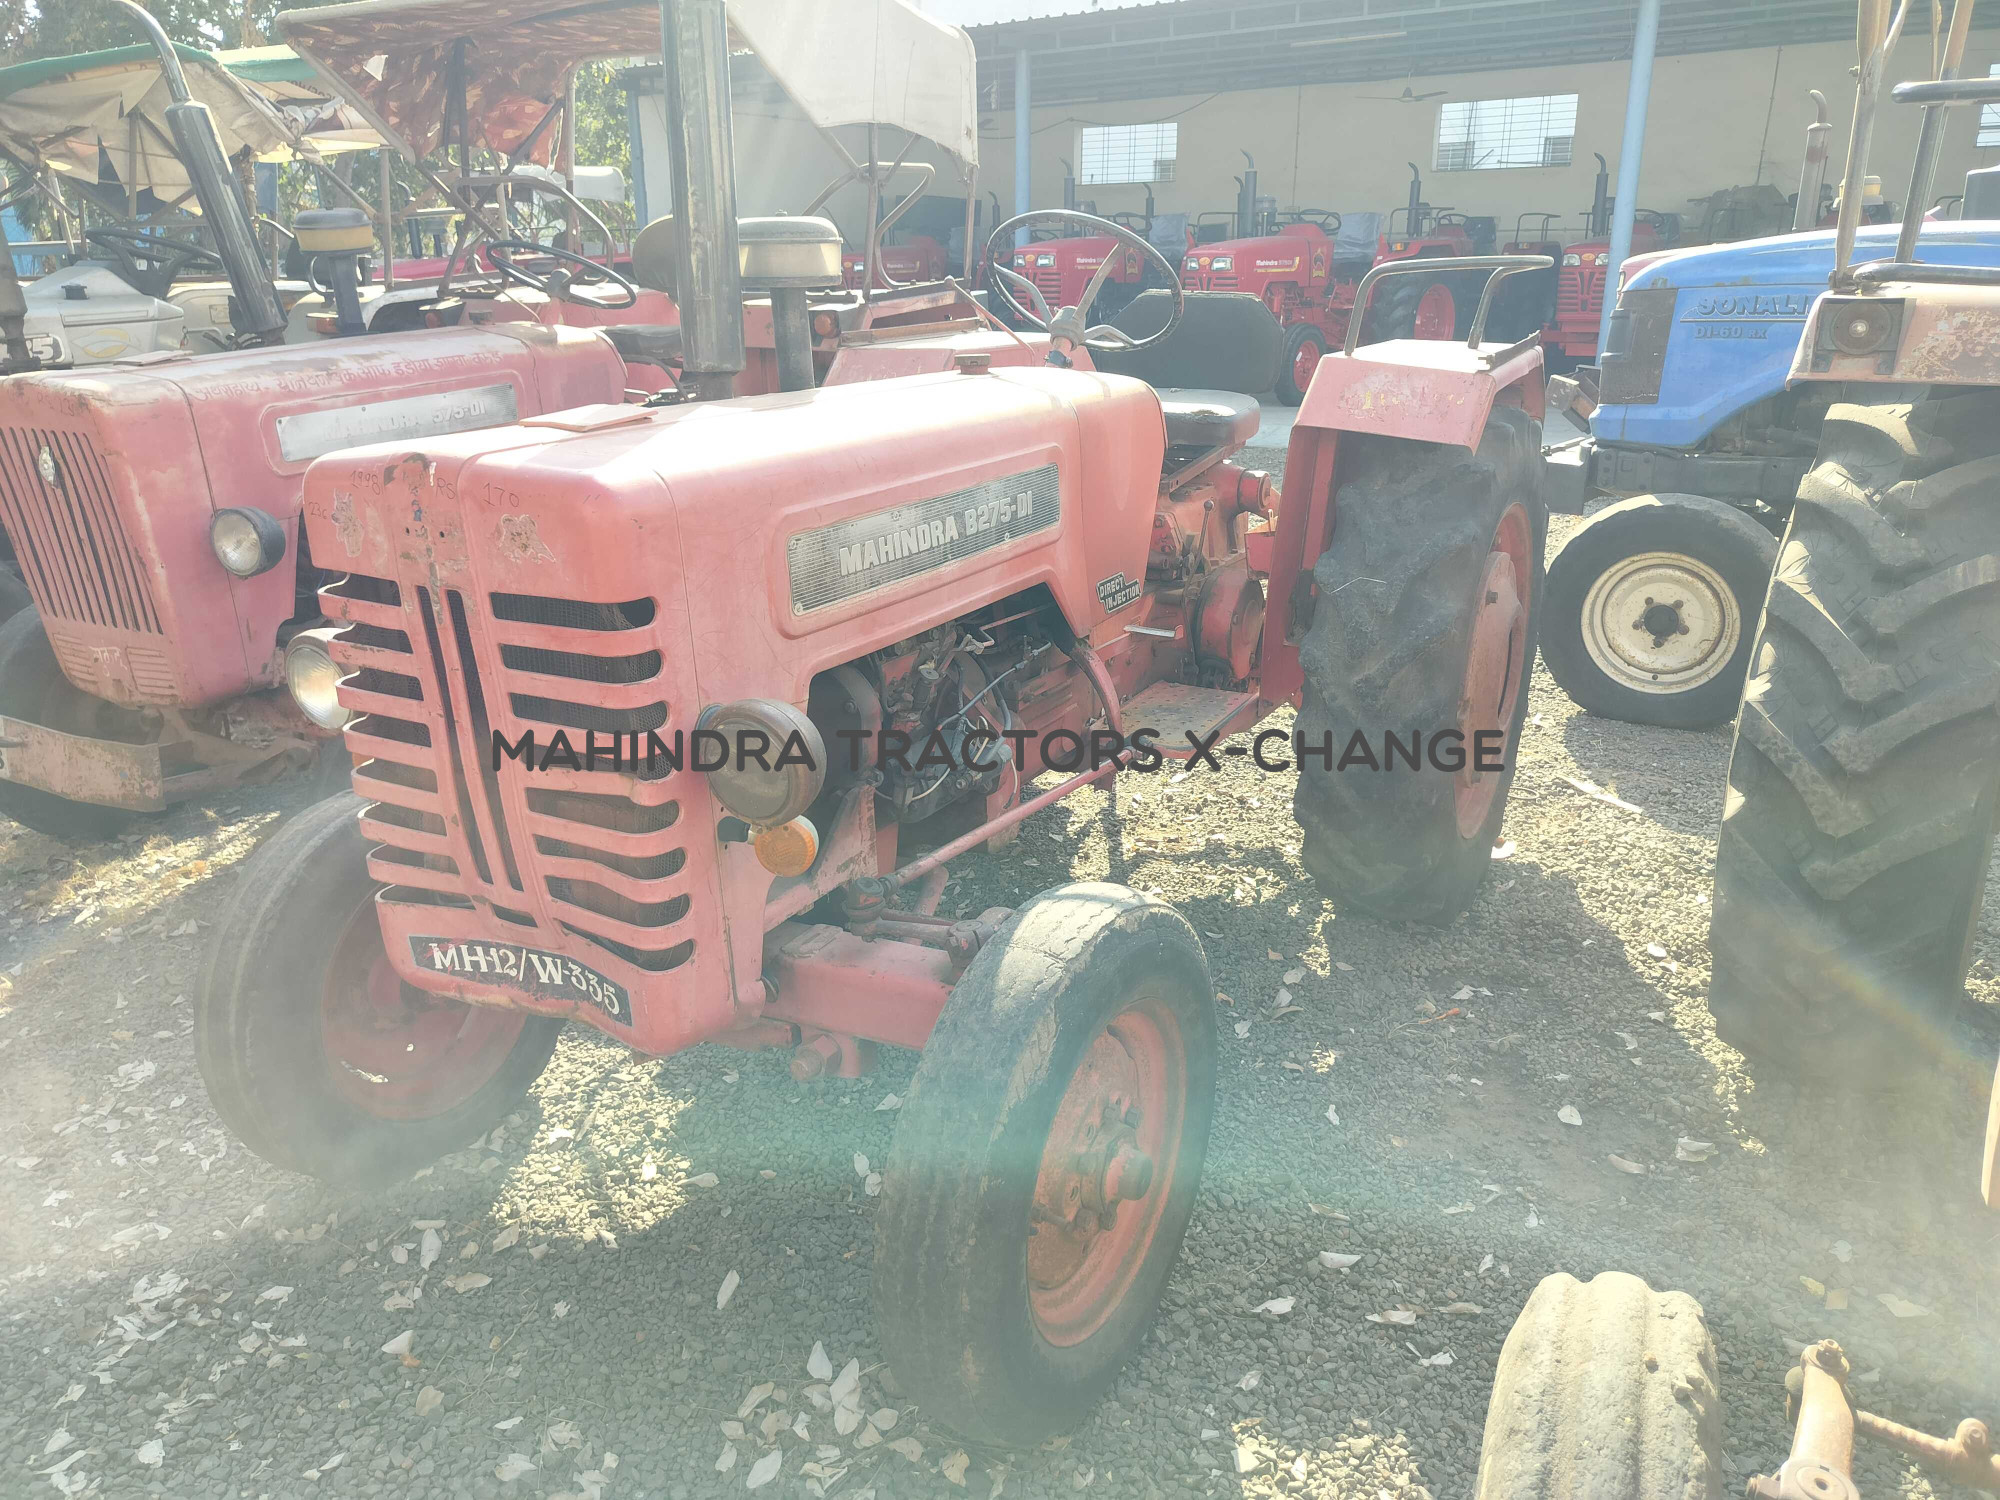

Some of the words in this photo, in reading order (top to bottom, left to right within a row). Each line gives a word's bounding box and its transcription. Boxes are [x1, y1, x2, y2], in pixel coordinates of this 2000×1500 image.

[839, 515, 960, 577] MAHINDRA
[964, 490, 1033, 537] B275-DI
[1100, 576, 1124, 598] DIRECT
[1106, 584, 1140, 610] INJECTION
